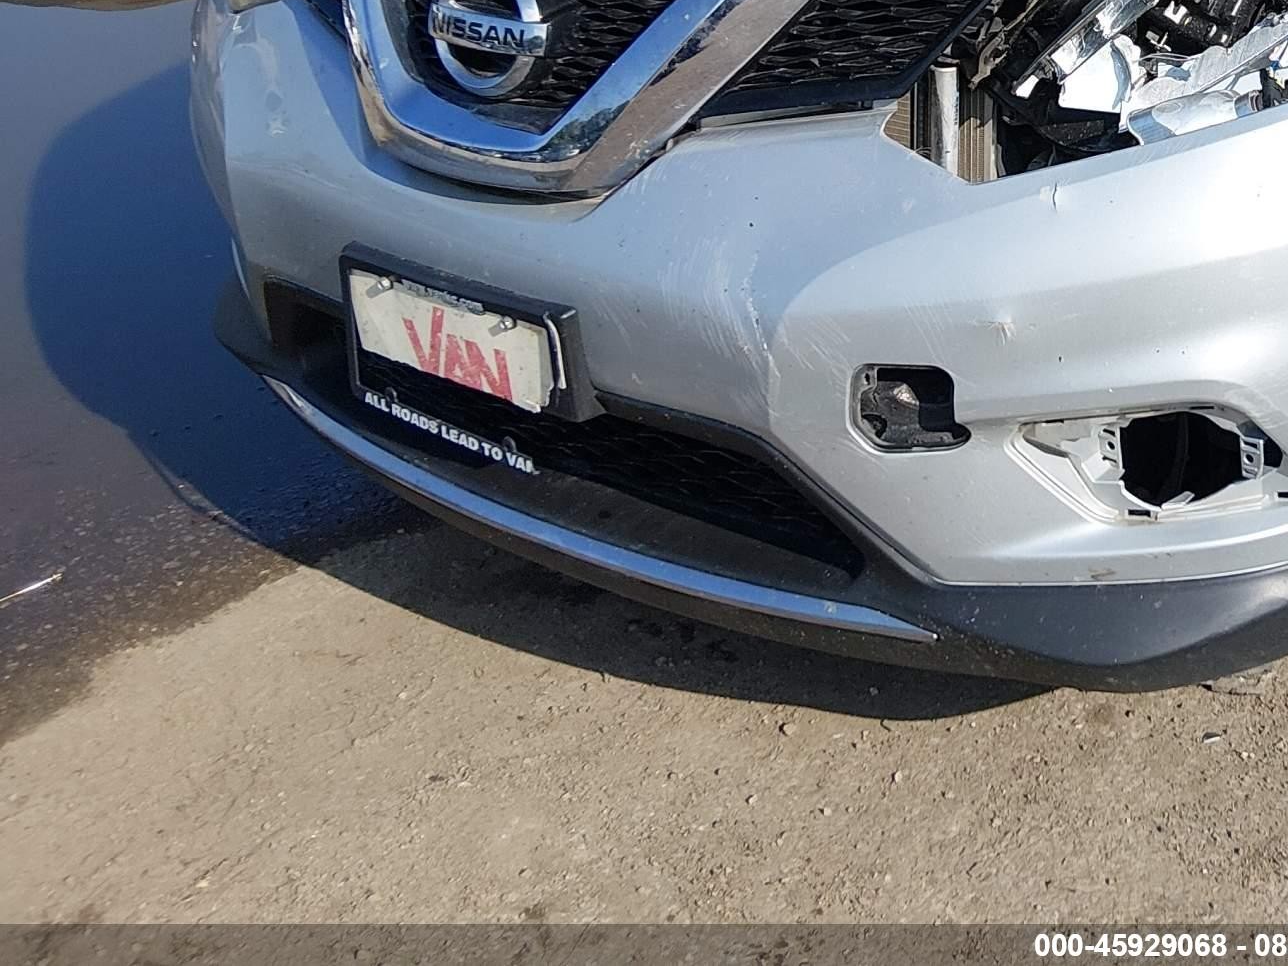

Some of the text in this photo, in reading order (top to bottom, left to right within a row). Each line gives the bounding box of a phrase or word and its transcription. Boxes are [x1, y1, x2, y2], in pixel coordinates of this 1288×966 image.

[432, 12, 525, 50] NISSAN
[402, 306, 513, 401] VAN
[364, 392, 390, 413] ALL
[391, 403, 439, 435] ROADS
[440, 424, 480, 452] LEAD
[481, 442, 503, 462] TO
